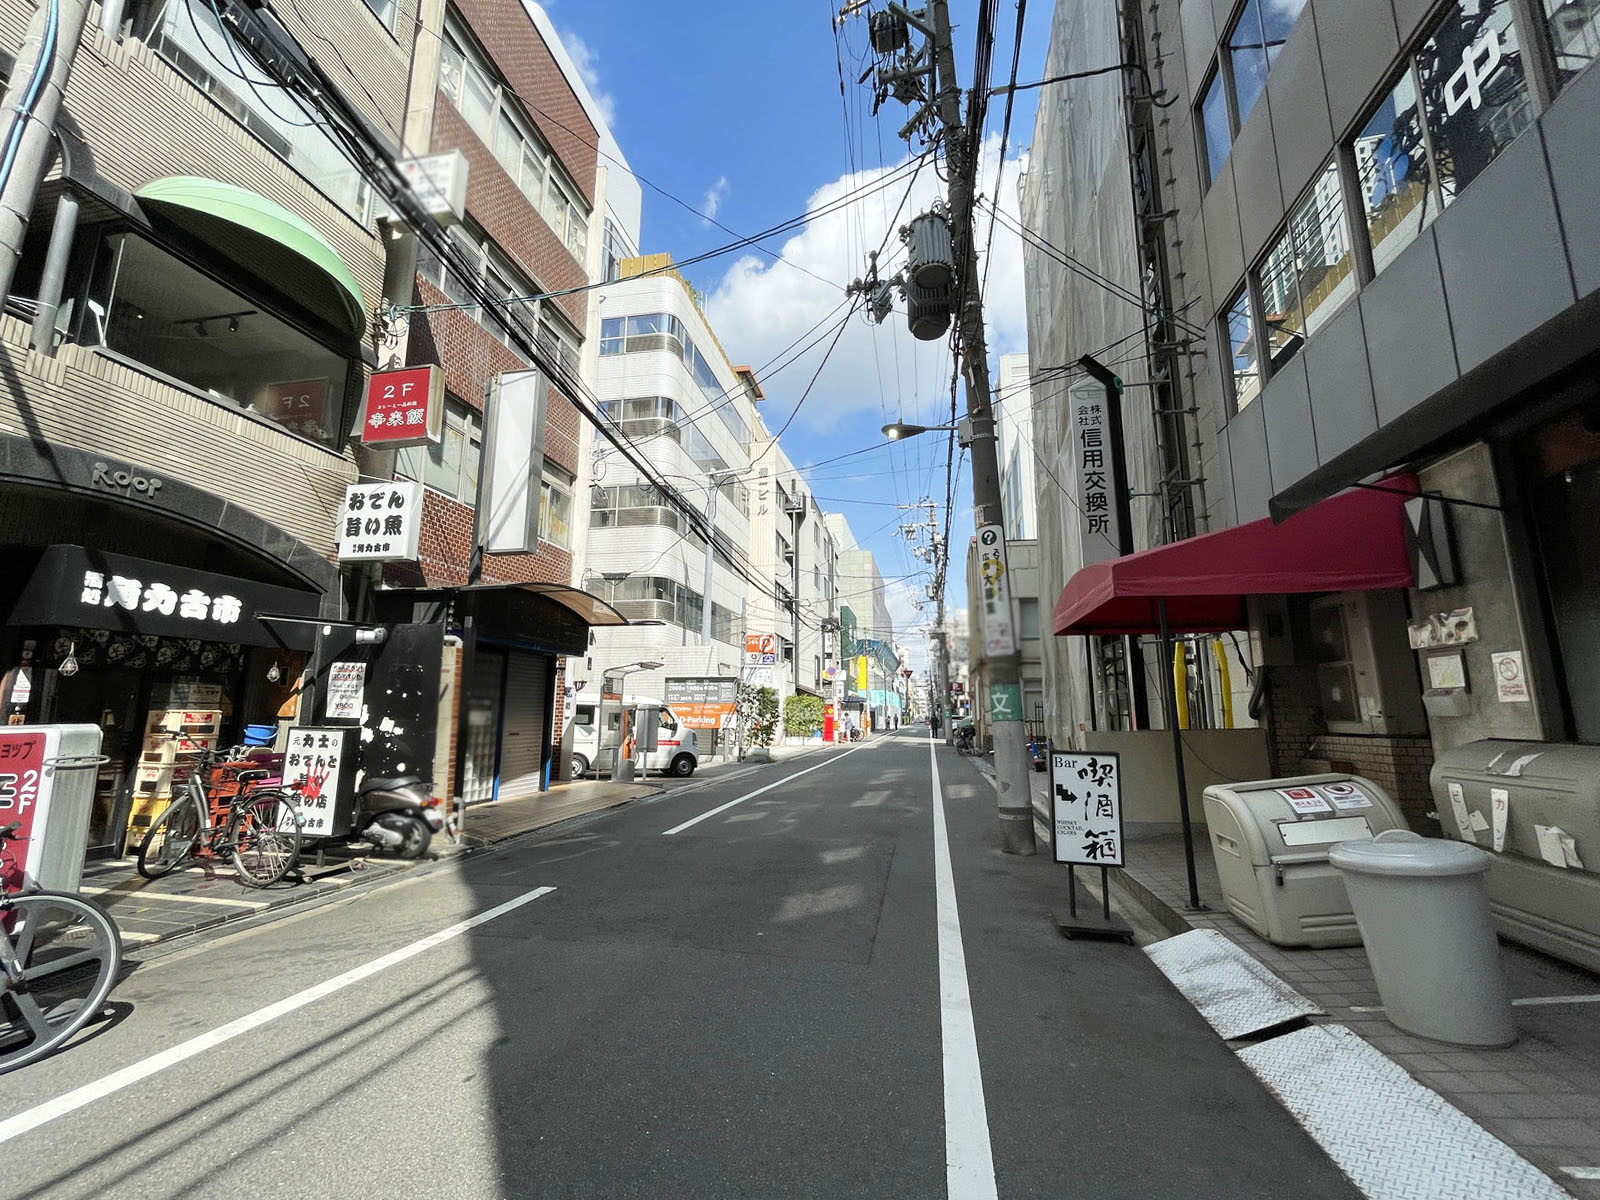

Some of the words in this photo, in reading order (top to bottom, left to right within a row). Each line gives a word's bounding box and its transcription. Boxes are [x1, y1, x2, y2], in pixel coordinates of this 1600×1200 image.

[383, 382, 415, 399] 2F
[1080, 428, 1110, 535] 信用交換所
[348, 490, 405, 512] おでん
[345, 514, 403, 538] 旨い魚
[991, 691, 1012, 713] 文
[292, 733, 339, 749] 元力士の
[288, 753, 338, 769] おでんと
[1054, 756, 1078, 769] Bar
